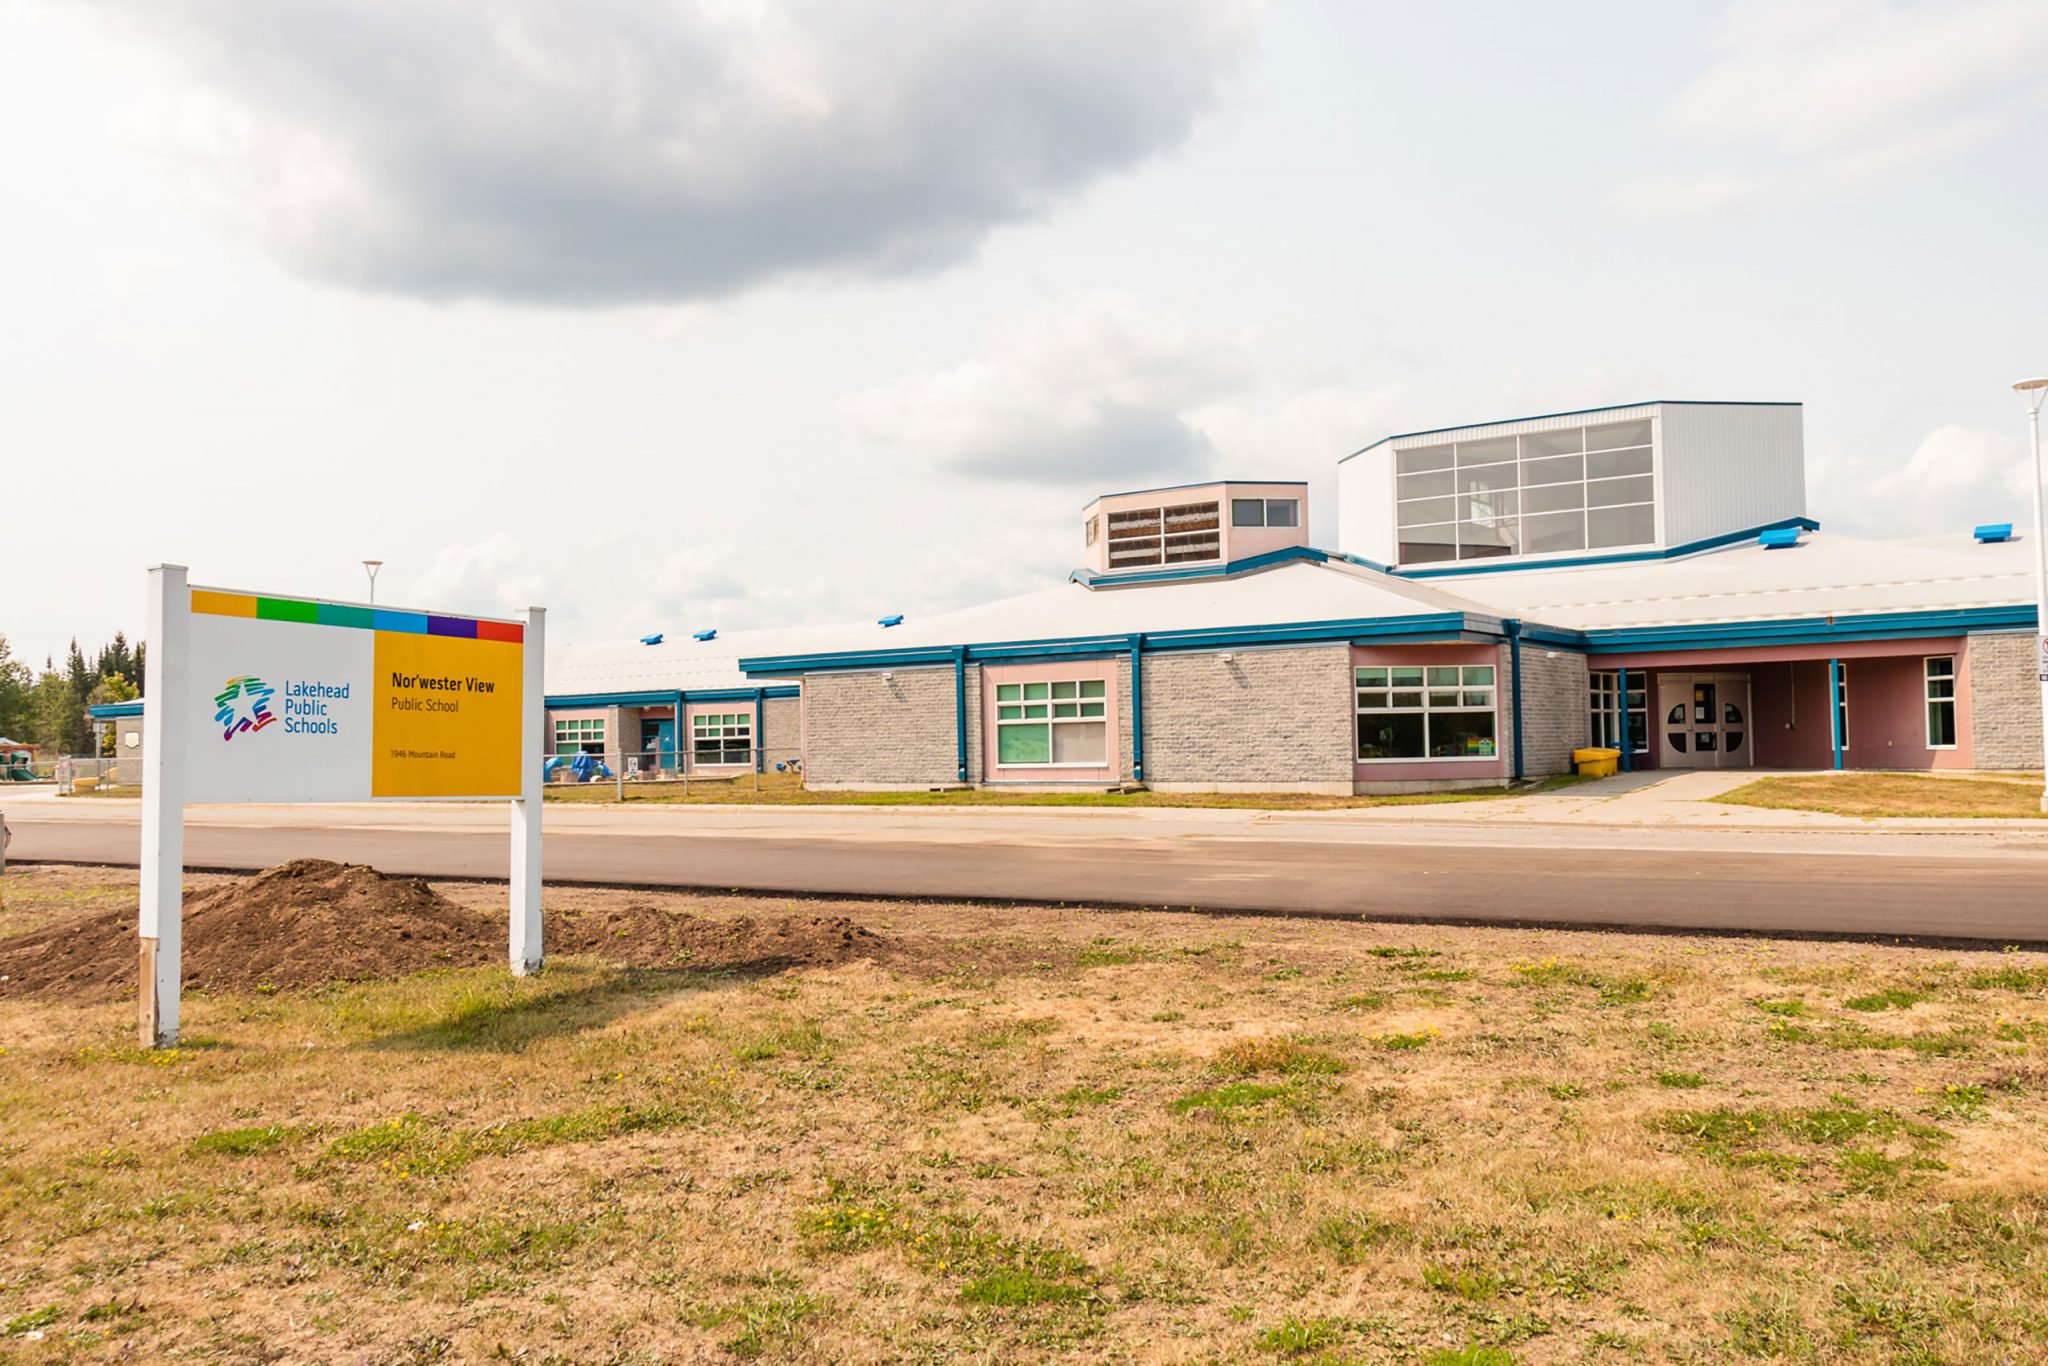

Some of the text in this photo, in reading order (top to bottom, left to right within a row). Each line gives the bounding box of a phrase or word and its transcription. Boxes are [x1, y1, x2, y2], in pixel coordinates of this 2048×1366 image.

[285, 680, 350, 699] Lakehead
[465, 676, 495, 693] View
[285, 698, 328, 716] Public
[391, 696, 459, 713] Public School
[284, 716, 338, 734] Schools
[390, 749, 456, 760] 1946 Mountain Road
